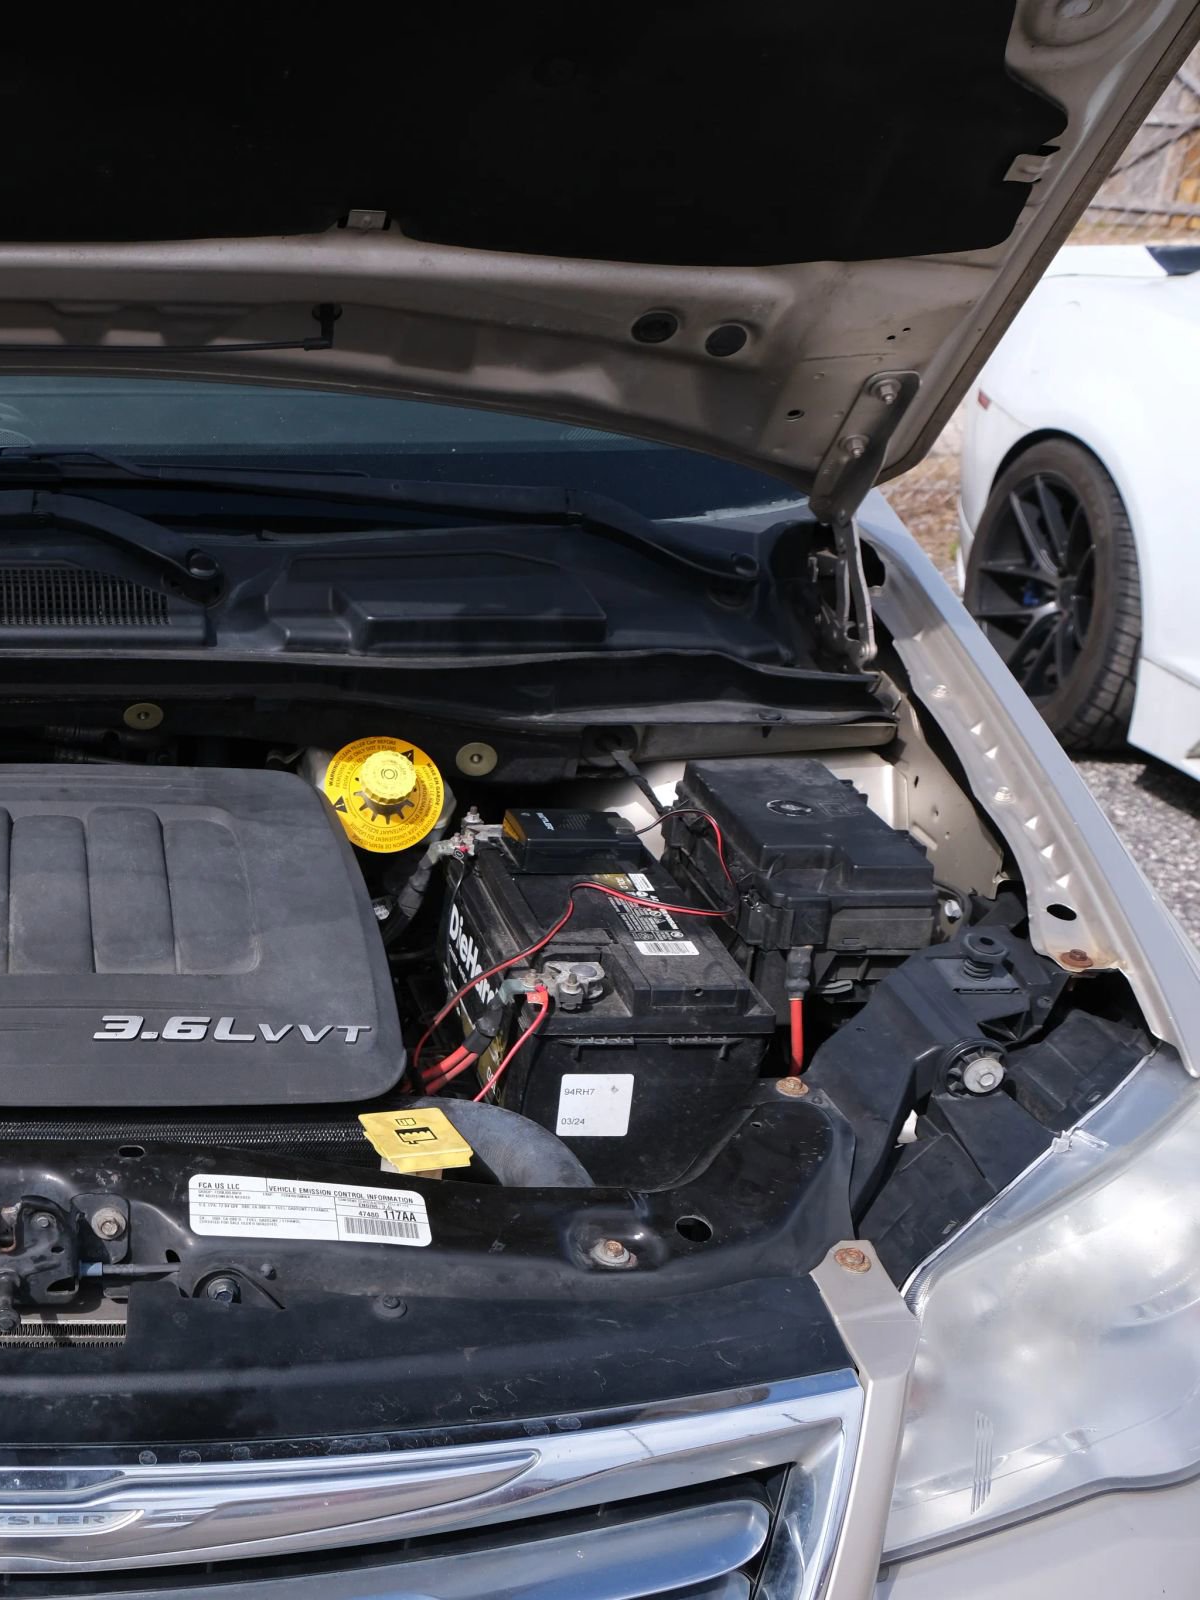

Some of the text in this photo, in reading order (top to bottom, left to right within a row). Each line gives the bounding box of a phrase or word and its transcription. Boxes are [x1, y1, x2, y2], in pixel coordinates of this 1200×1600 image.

[93, 1015, 372, 1043] 3.6L VVT
[564, 1088, 595, 1096] 94RH7
[561, 1117, 585, 1125] 03/24
[367, 1194, 414, 1203] INFORMATION
[384, 1210, 416, 1221] 117AA
